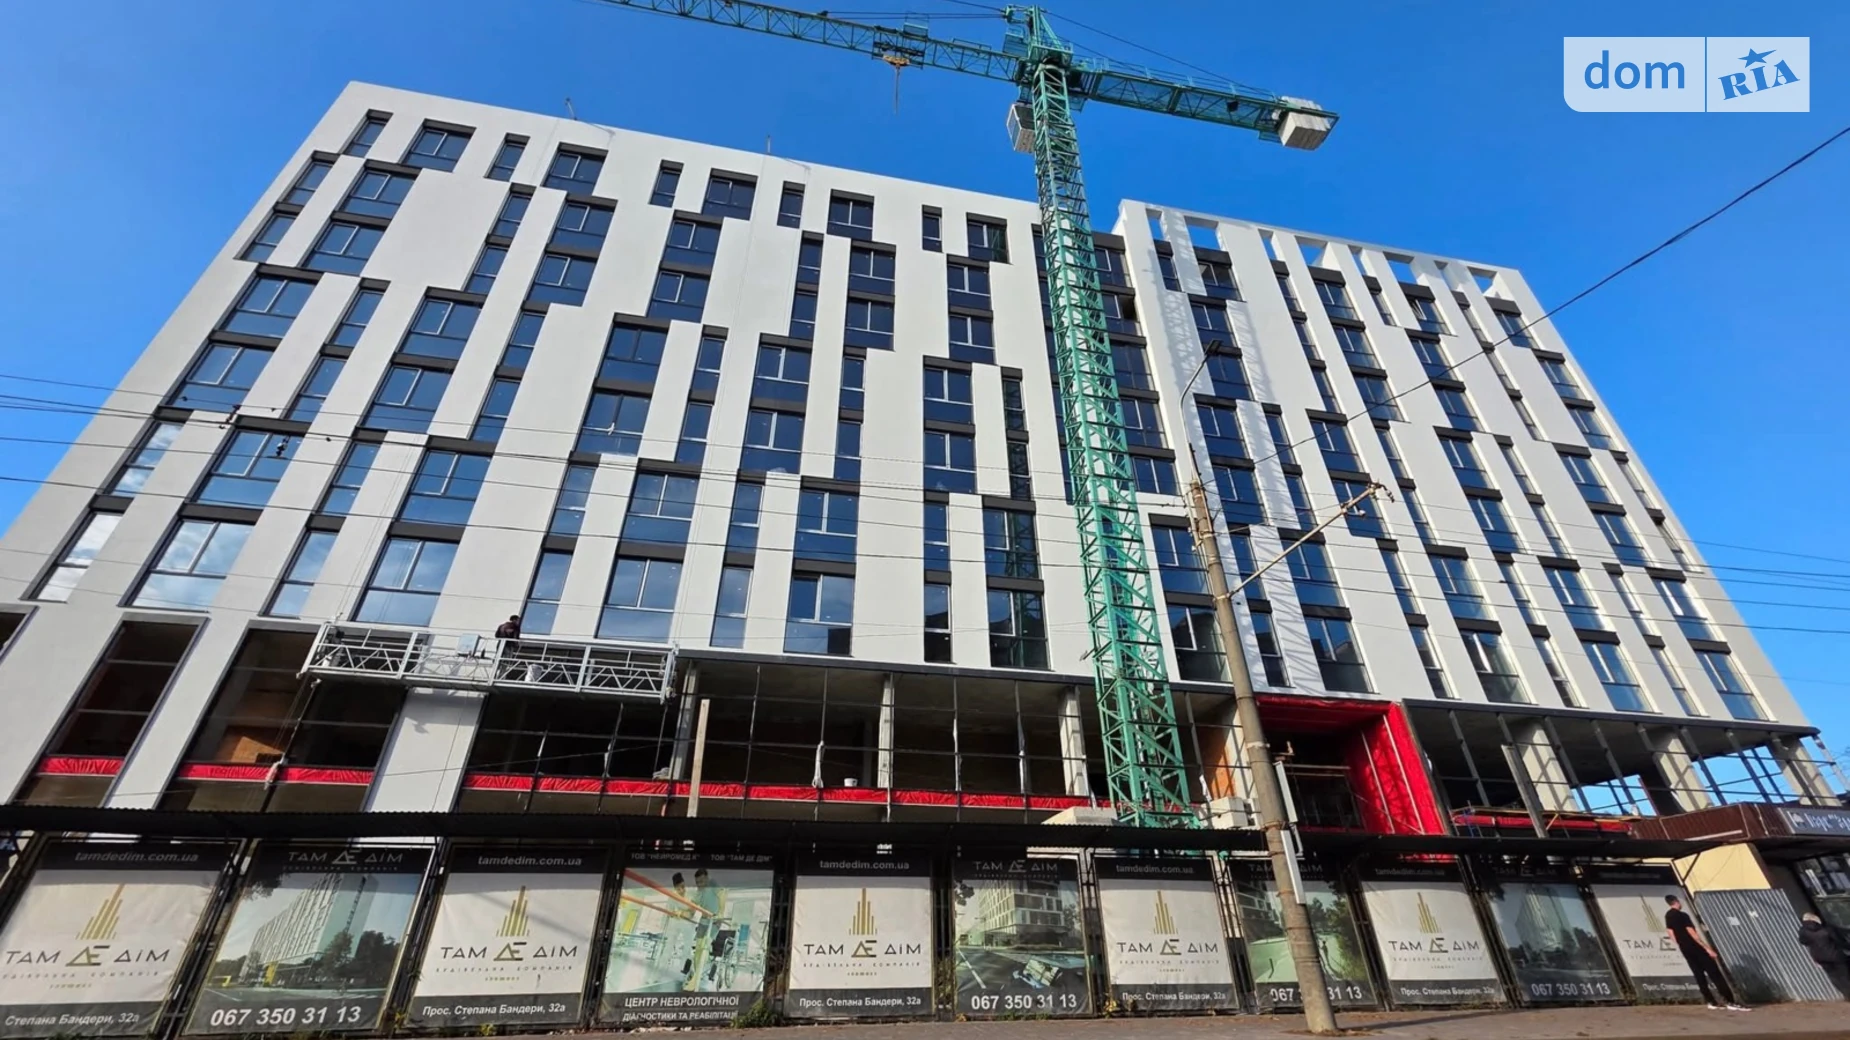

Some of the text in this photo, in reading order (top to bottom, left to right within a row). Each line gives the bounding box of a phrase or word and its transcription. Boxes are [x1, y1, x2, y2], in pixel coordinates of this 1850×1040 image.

[75, 852, 199, 862] tamdedim.com.ua
[288, 851, 328, 862] ТАМ
[364, 852, 404, 863] ДІМ
[478, 856, 582, 866] tamdedim.com.ua
[819, 860, 910, 870] tamdedim.com.ua
[974, 861, 1003, 871] ТАМ
[1115, 864, 1194, 874] tamdedim.com.ua
[804, 943, 844, 955] ТАМ
[884, 943, 921, 955] ДІМ
[1117, 942, 1153, 953] ТАМ
[1188, 942, 1219, 953] ДІМ
[1388, 940, 1423, 951] ТАМ
[1624, 939, 1653, 949] ТАМ
[5, 950, 61, 964] ТАМ
[114, 949, 170, 963] ДІМ
[440, 946, 487, 959] ТАМ
[533, 945, 578, 959] ДІМ
[1270, 987, 1294, 1002] 067
[1345, 985, 1363, 1000] 13
[1532, 982, 1611, 996] 067 350 31 13
[624, 995, 739, 1008] ЦЕНТР НЕВРОЛОГІЧНОЇ
[800, 996, 921, 1009] Прос. Степана Бандери, 32а
[971, 993, 1077, 1010] 067 350 31 13
[210, 1005, 361, 1026] 067 350 31 13
[422, 1002, 566, 1017] Прос. Степана Бандери, 32а
[678, 1011, 689, 1020] ТА
[5, 1012, 139, 1026] Степана Бандери, 32а
